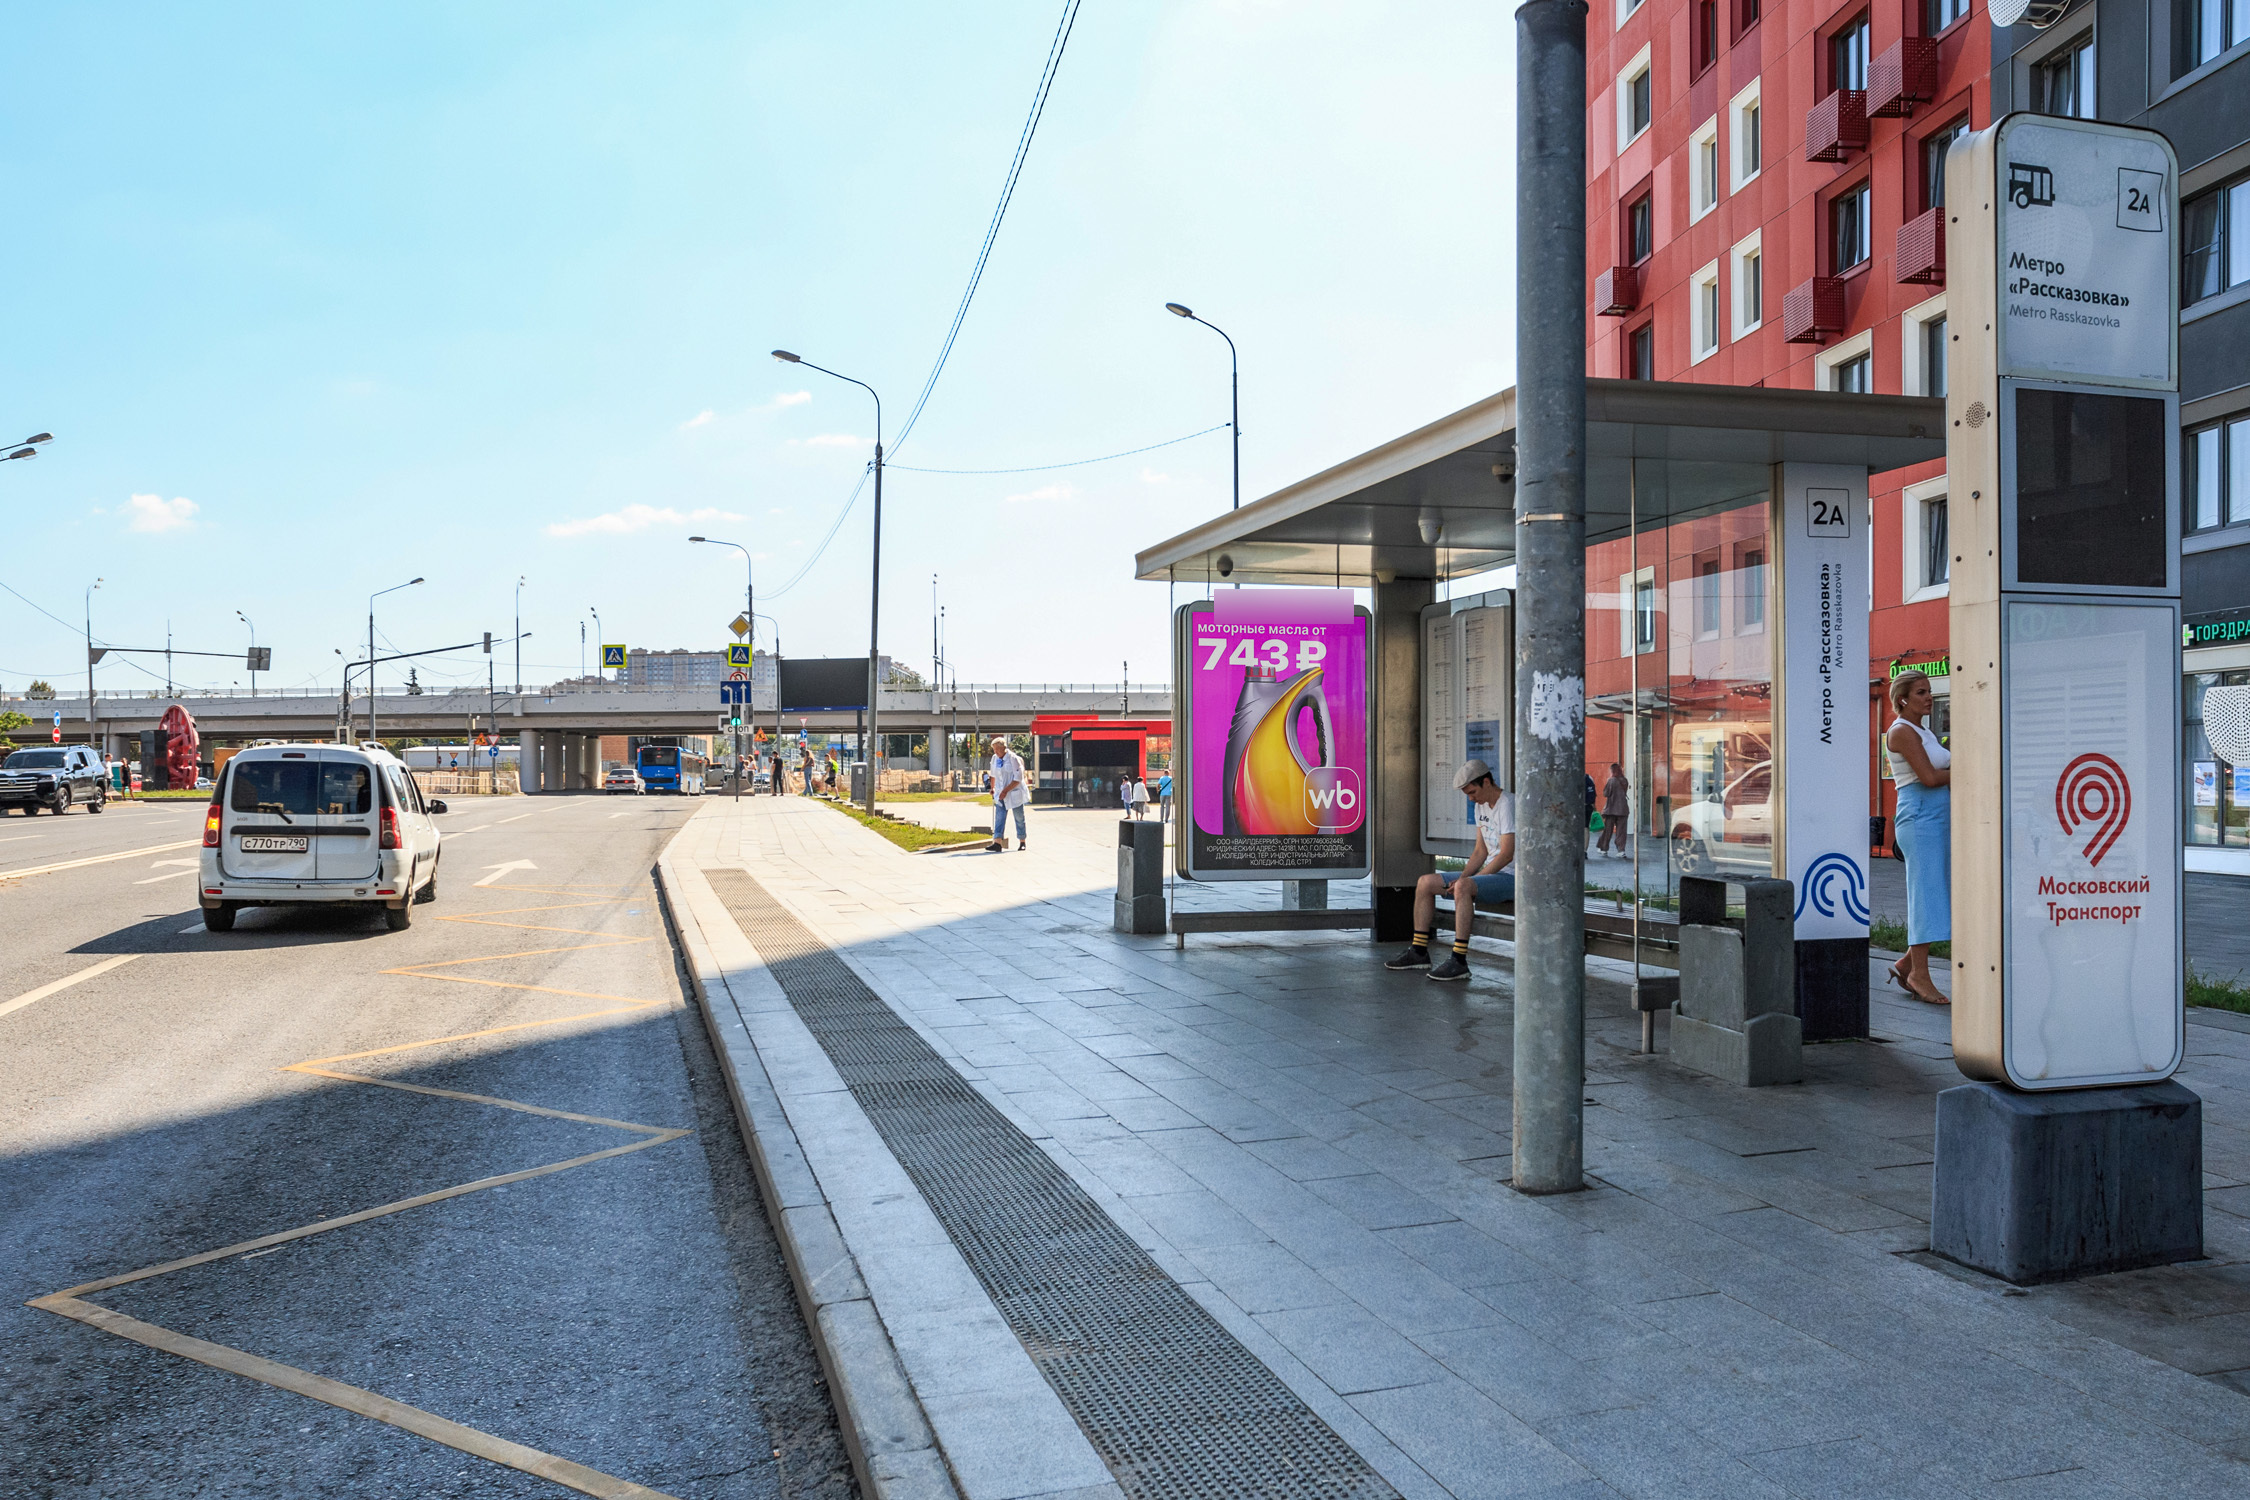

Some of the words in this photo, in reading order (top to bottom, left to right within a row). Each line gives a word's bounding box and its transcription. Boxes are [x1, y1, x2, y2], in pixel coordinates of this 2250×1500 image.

[2127, 187, 2151, 214] 2А
[2009, 251, 2065, 276] Метро
[2009, 277, 2130, 308] «Рассказовка»
[2009, 304, 2047, 320] Metro
[2050, 308, 2121, 328] Rasskazovka
[1812, 500, 1845, 526] 2А
[1834, 563, 1843, 632] Rasskazovka
[1197, 623, 1266, 636] моторные
[1268, 625, 1309, 636] масла
[1311, 626, 1327, 636] от
[1818, 563, 1831, 684] «Рассказовка»
[1835, 634, 1844, 669] Metro
[727, 725, 750, 733] СОП
[1820, 689, 1834, 745] Метро
[1307, 780, 1356, 810] wb
[2038, 875, 2150, 895] Московский
[2046, 901, 2141, 926] Транспорт
